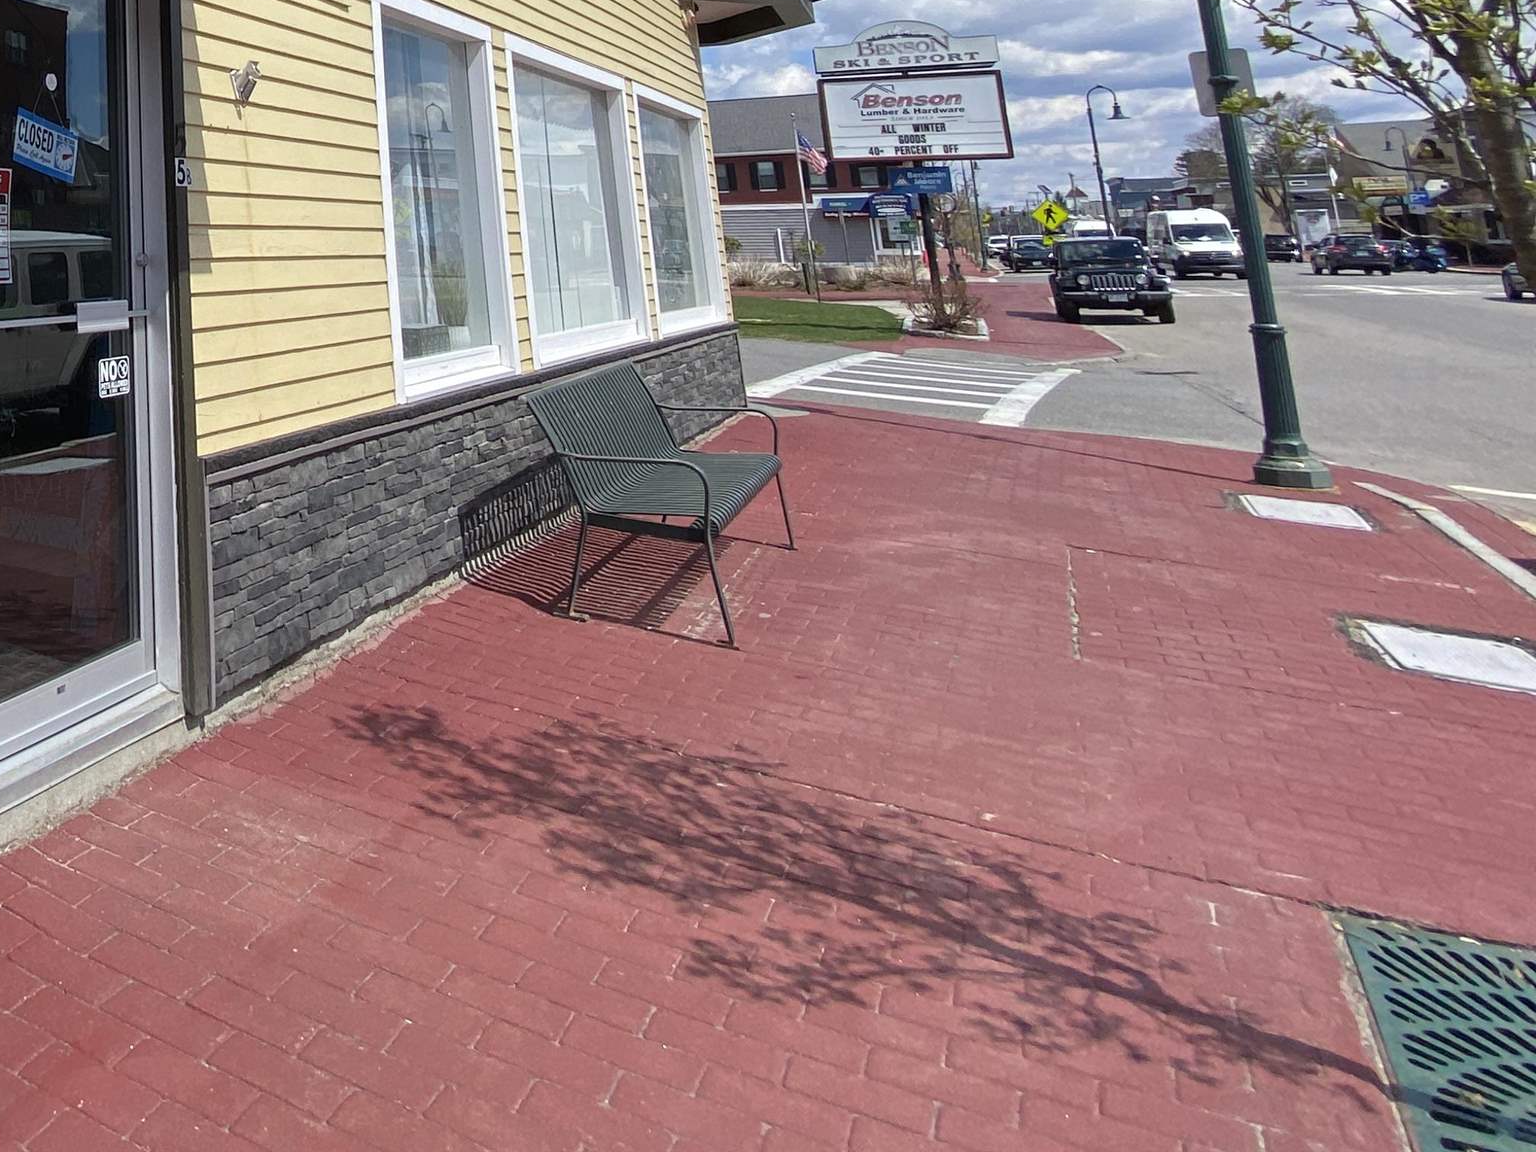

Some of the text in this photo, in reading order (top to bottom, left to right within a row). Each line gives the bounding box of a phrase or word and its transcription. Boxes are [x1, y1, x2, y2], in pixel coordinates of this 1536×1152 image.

[856, 35, 950, 57] BENSON
[833, 52, 980, 69] SKI & SPORT
[861, 93, 963, 109] Benson
[860, 109, 898, 117] Lumber
[913, 106, 966, 114] Hardware
[18, 118, 54, 154] CLOSED
[881, 123, 947, 134] ALL WINTER
[898, 134, 927, 144] GOODS
[894, 145, 933, 155] PERCENT
[943, 144, 959, 154] OFF
[100, 360, 118, 382] NO
